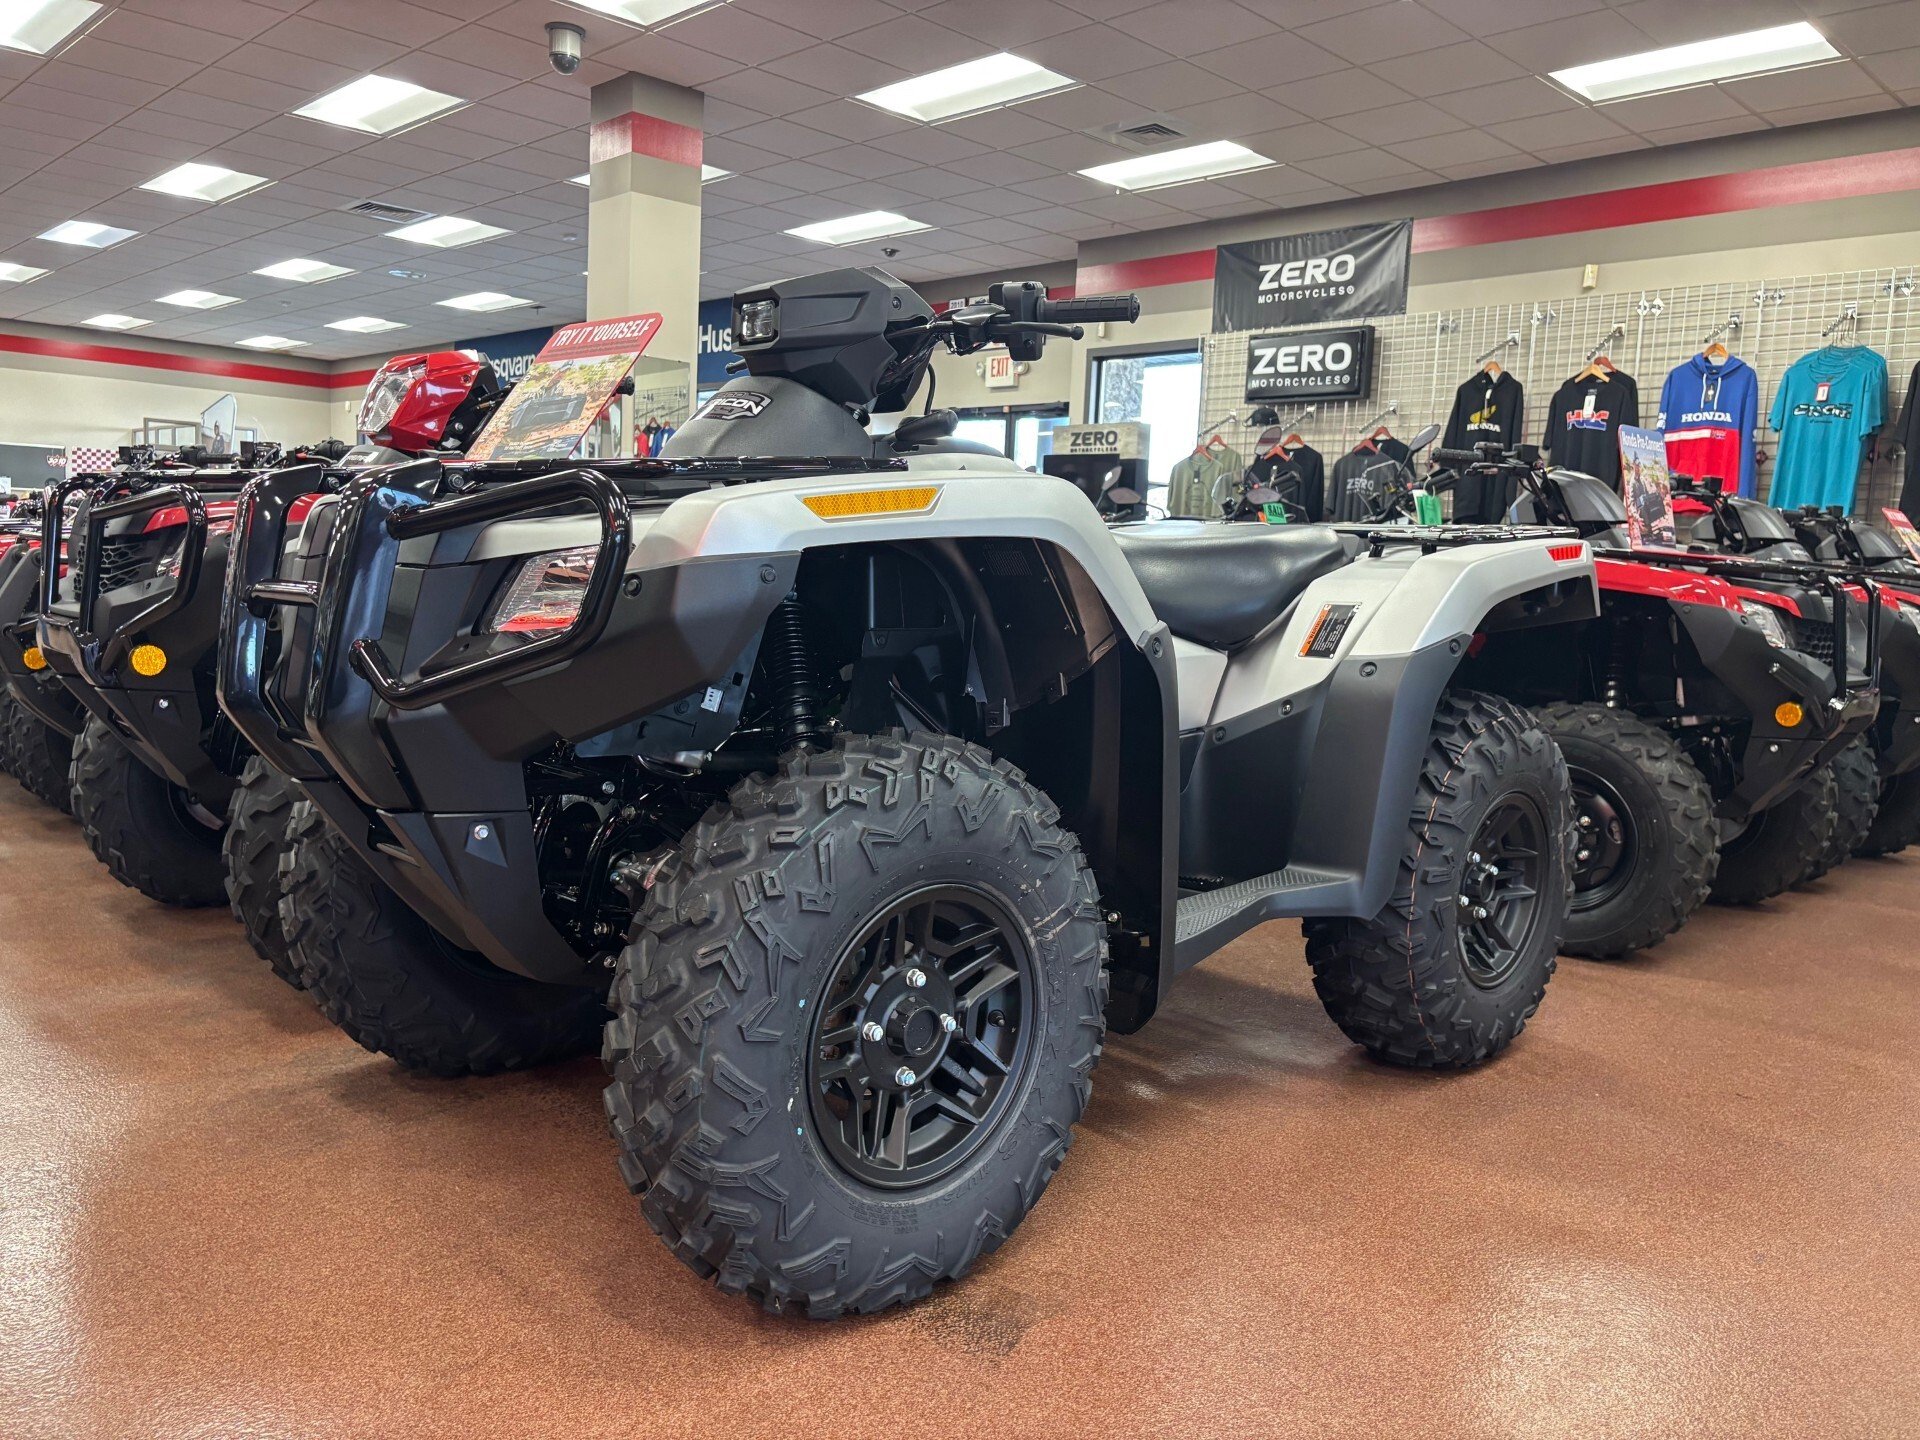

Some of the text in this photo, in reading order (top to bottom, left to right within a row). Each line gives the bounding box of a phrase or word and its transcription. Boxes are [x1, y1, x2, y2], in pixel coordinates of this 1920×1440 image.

[1259, 254, 1356, 290] ZERO
[552, 318, 656, 347] TRY IT YOURSELF
[990, 357, 1010, 377] EXIT
[1252, 342, 1353, 375] ZERO
[1681, 411, 1733, 423] HONDA
[1466, 422, 1501, 433] HONDA
[1070, 430, 1118, 447] ZERO
[1622, 430, 1637, 448] Honda
[1346, 478, 1374, 490] ZERO
